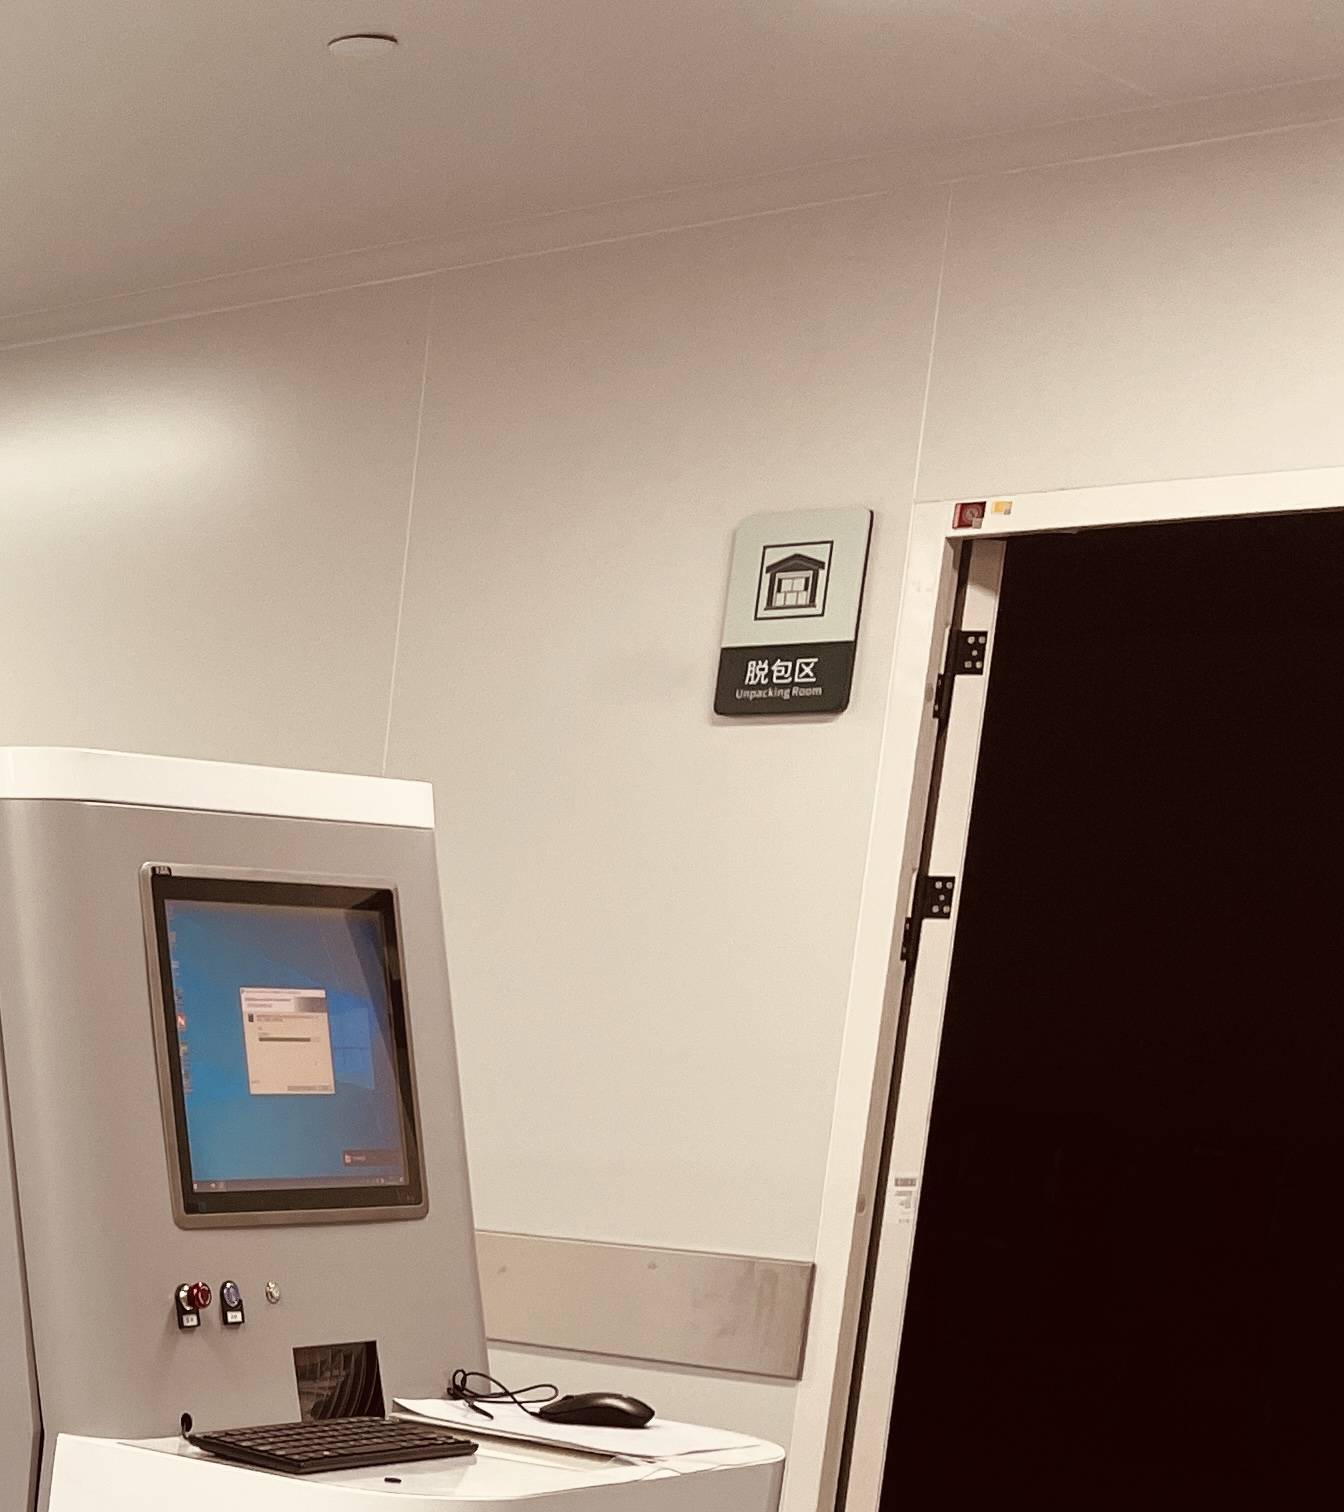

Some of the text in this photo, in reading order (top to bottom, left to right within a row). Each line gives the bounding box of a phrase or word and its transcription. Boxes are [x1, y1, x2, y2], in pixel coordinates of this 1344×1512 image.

[745, 658, 819, 685] 脱包区
[735, 686, 822, 700] Unpacking Room
